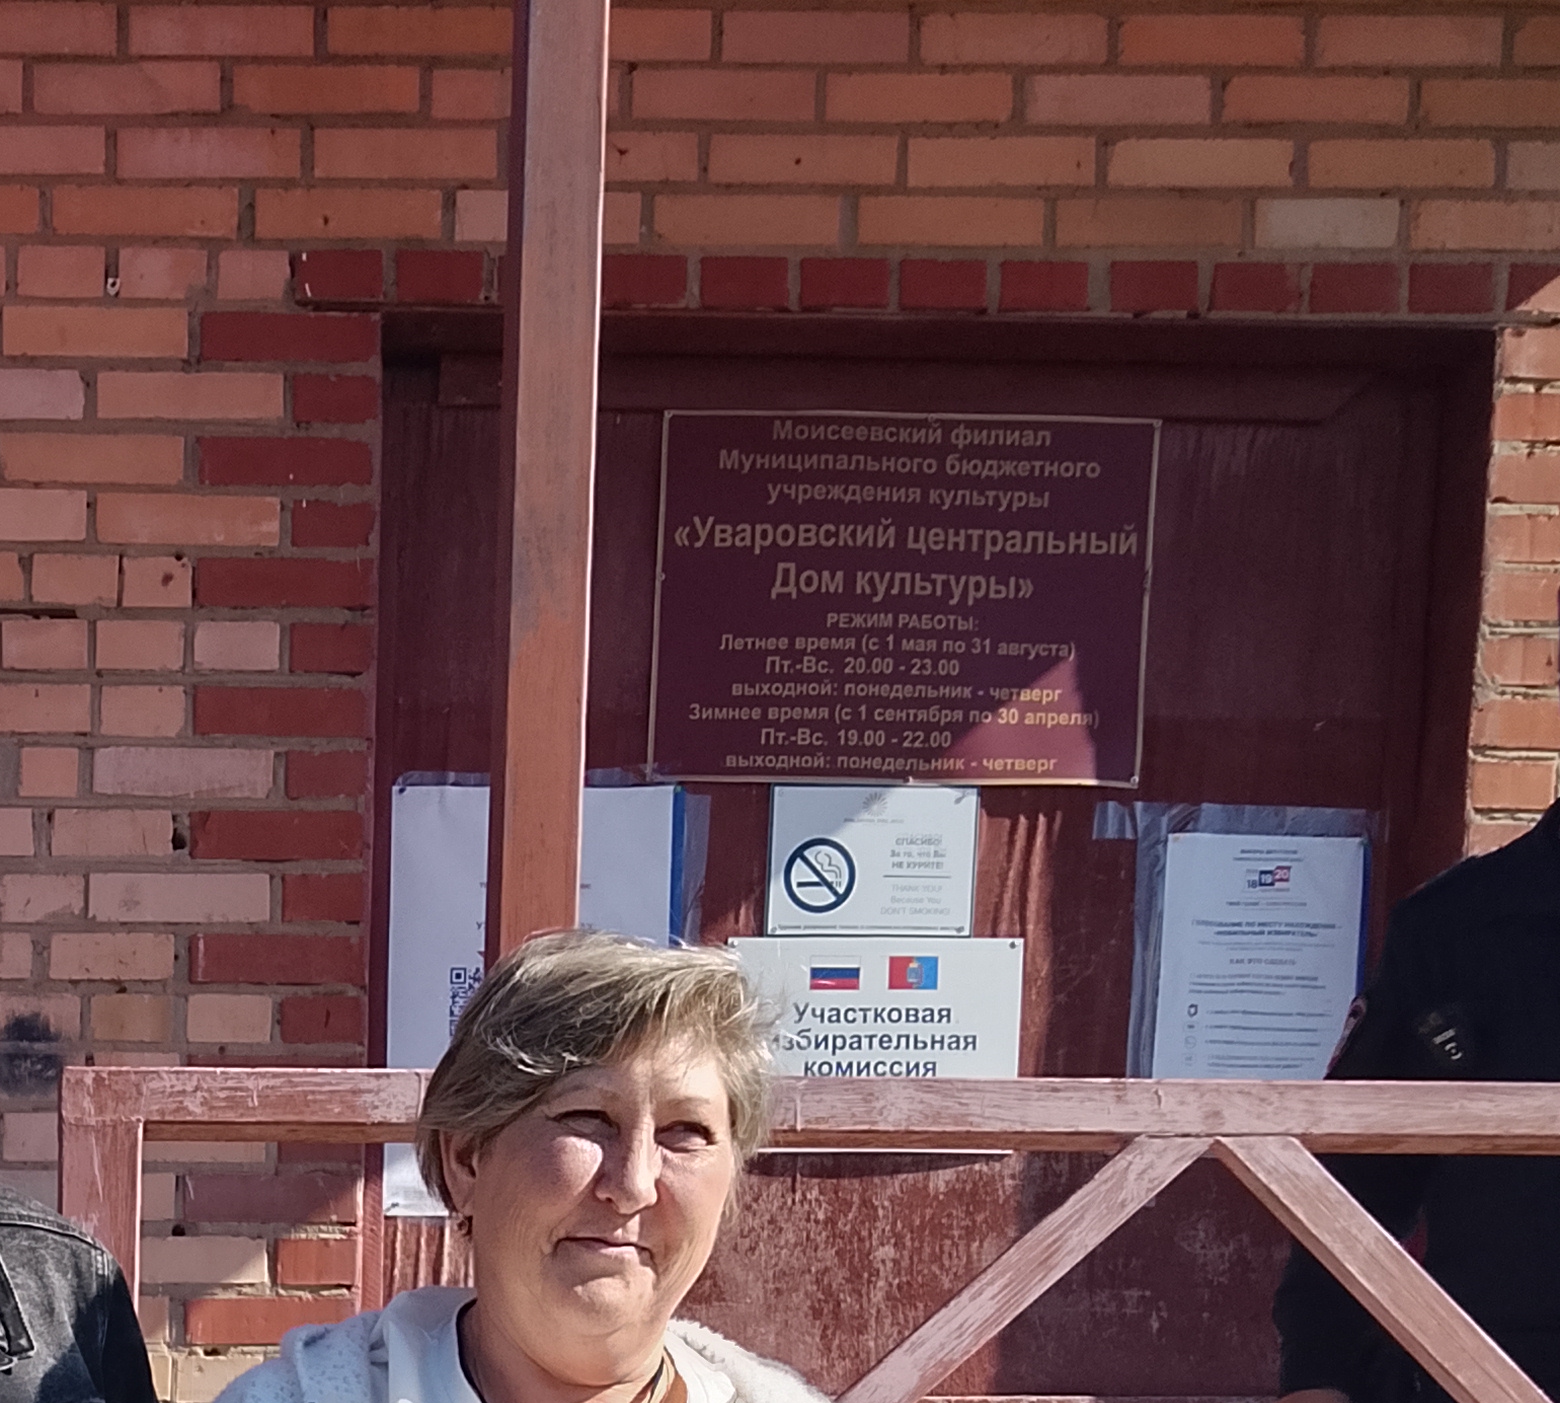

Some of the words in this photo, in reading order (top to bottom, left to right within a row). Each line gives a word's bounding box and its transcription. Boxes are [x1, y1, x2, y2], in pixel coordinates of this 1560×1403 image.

[772, 419, 942, 443] Моисеевский
[950, 423, 1052, 449] филиал
[718, 449, 938, 474] Муниципального
[945, 453, 1101, 480] бюджетного
[766, 482, 922, 505] учреждения
[928, 487, 1050, 512] культуры
[673, 515, 896, 555] «Уваровский
[907, 523, 1138, 561] центральный
[770, 561, 845, 600] Дом
[855, 570, 1035, 606] культуры»
[826, 612, 893, 628] РЕЖИМ
[898, 612, 980, 631] РАБОТЫ:
[719, 633, 789, 651] Летнее
[794, 636, 856, 653] время
[861, 633, 880, 654] (с
[886, 633, 894, 651] 1
[901, 637, 938, 652] мая
[942, 639, 966, 653] по
[970, 637, 990, 655] 31
[997, 641, 1076, 662] августа)
[765, 655, 835, 674] Пт.-Вс.
[843, 656, 894, 675] 20.00
[909, 658, 960, 676] 23.00
[731, 678, 839, 698] выходной:
[844, 682, 973, 700] понедельник
[989, 685, 1063, 705] четверг
[688, 703, 762, 720] Зимнее
[767, 706, 829, 723] время
[834, 703, 852, 724] (с
[857, 704, 867, 721] 1
[873, 705, 964, 726] сентября
[969, 710, 992, 724] по
[997, 707, 1020, 725] 30
[1024, 711, 1100, 729] апреля)
[760, 727, 829, 746] Пт.-Вс.
[837, 729, 886, 747] 19.00
[902, 730, 952, 748] 22.00
[724, 751, 832, 771] выходной:
[837, 755, 965, 773] понедельник
[982, 757, 1059, 775] четверг
[891, 861, 904, 869] НЕ
[1246, 879, 1258, 889] 18
[1260, 873, 1273, 884] 19
[1273, 868, 1290, 880] 20
[792, 1001, 952, 1024] Участковая
[803, 1060, 938, 1078] комиссия
